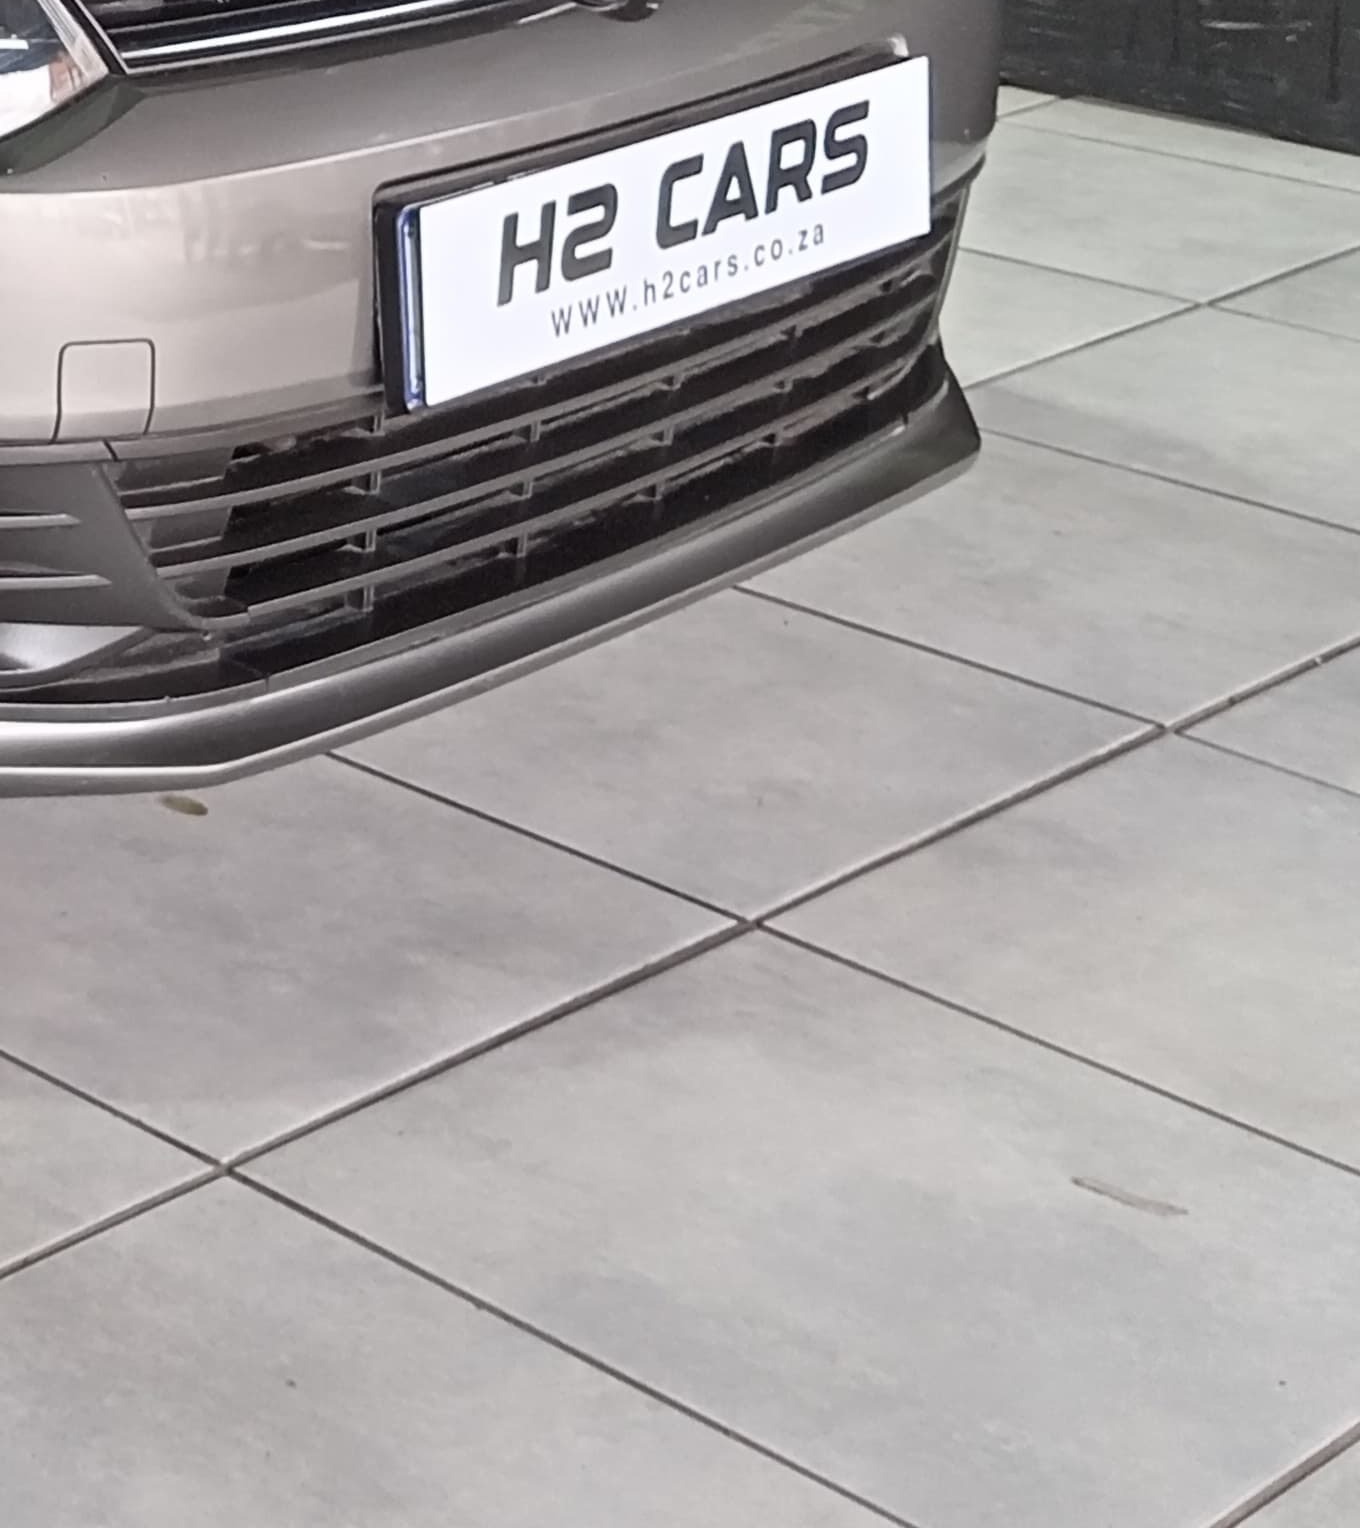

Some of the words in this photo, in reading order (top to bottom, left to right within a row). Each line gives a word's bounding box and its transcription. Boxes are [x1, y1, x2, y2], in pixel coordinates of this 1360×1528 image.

[497, 183, 618, 307] H2
[655, 100, 870, 250] CARS
[551, 223, 825, 338] www.h2cars.co.za
